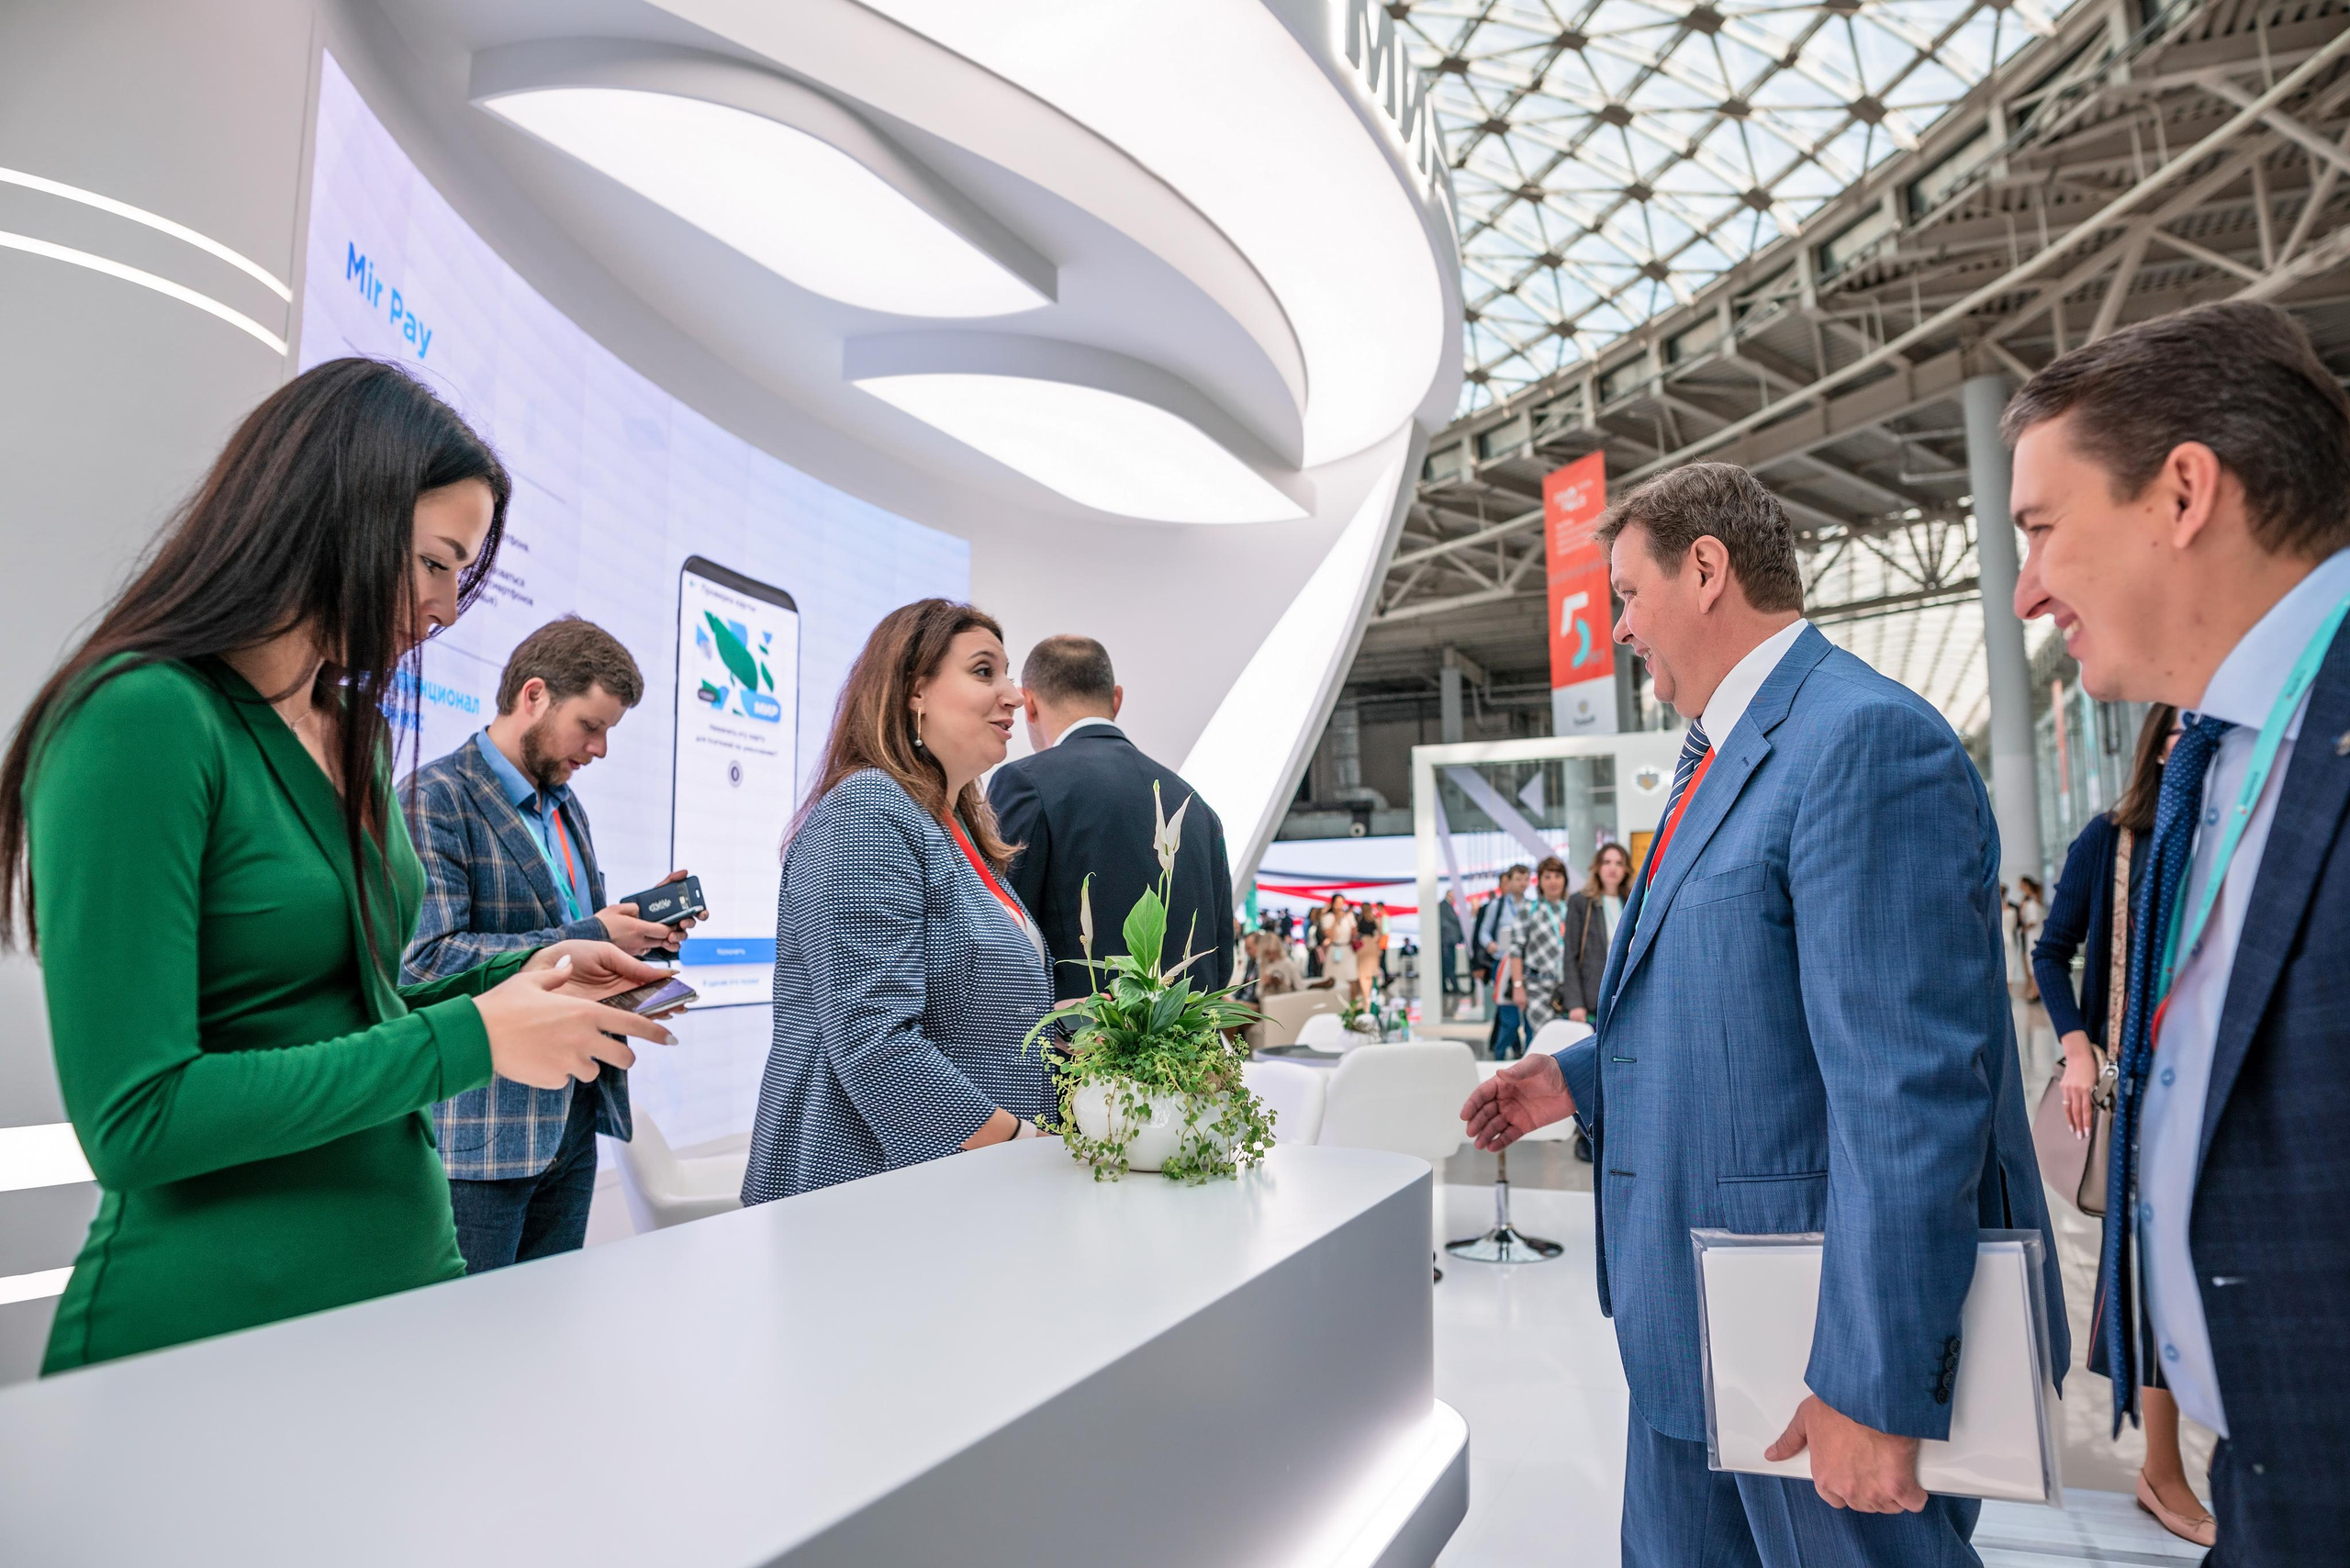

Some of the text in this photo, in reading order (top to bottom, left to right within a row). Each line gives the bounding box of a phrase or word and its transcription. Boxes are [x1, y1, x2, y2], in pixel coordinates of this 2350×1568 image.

[346, 241, 432, 360] Mir Pay
[754, 700, 779, 718] МИР
